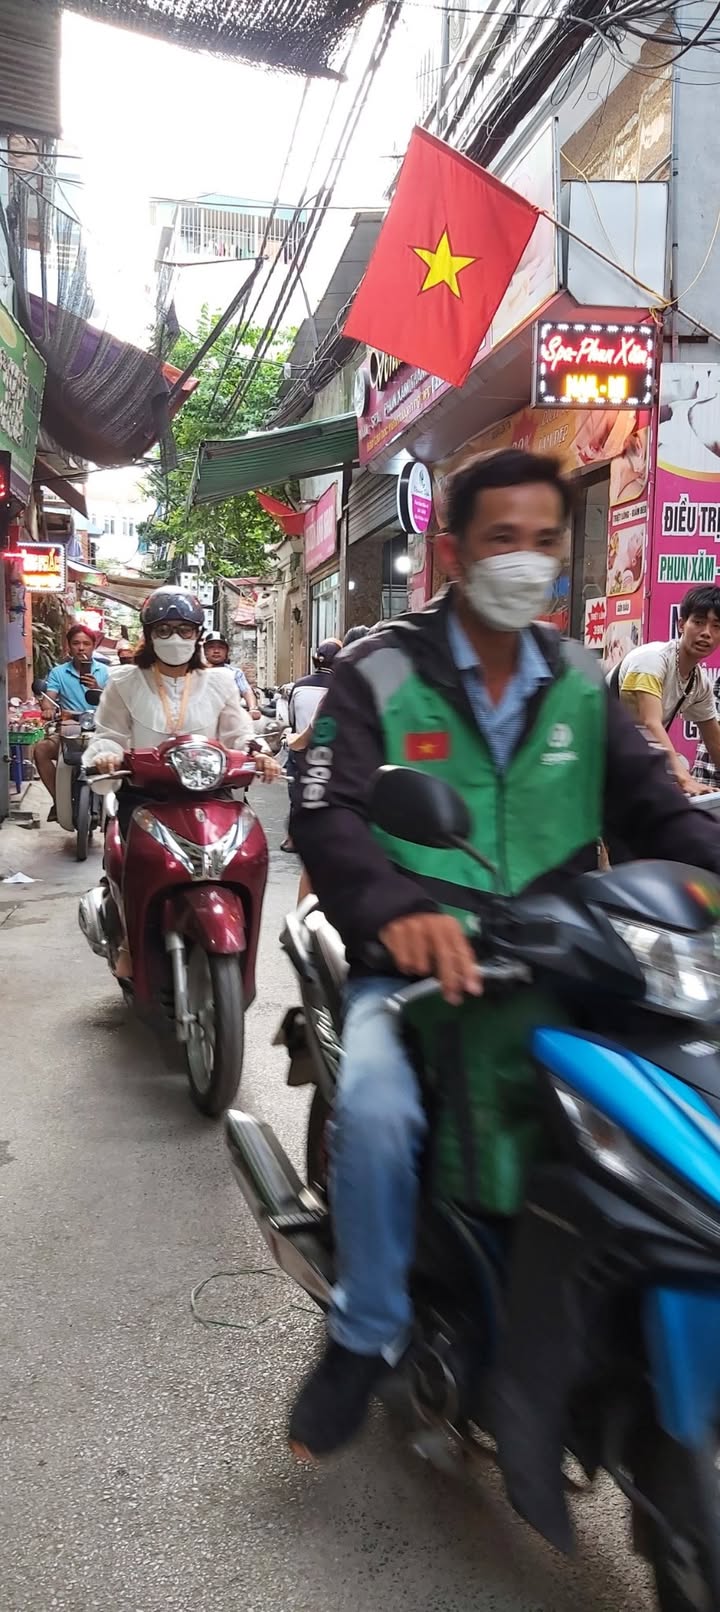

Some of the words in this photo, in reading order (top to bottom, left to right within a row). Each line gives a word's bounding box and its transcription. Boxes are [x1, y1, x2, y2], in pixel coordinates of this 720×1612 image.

[663, 497, 696, 533] ĐIỀU
[659, 556, 688, 581] PHUN
[690, 550, 715, 581] XĂM
